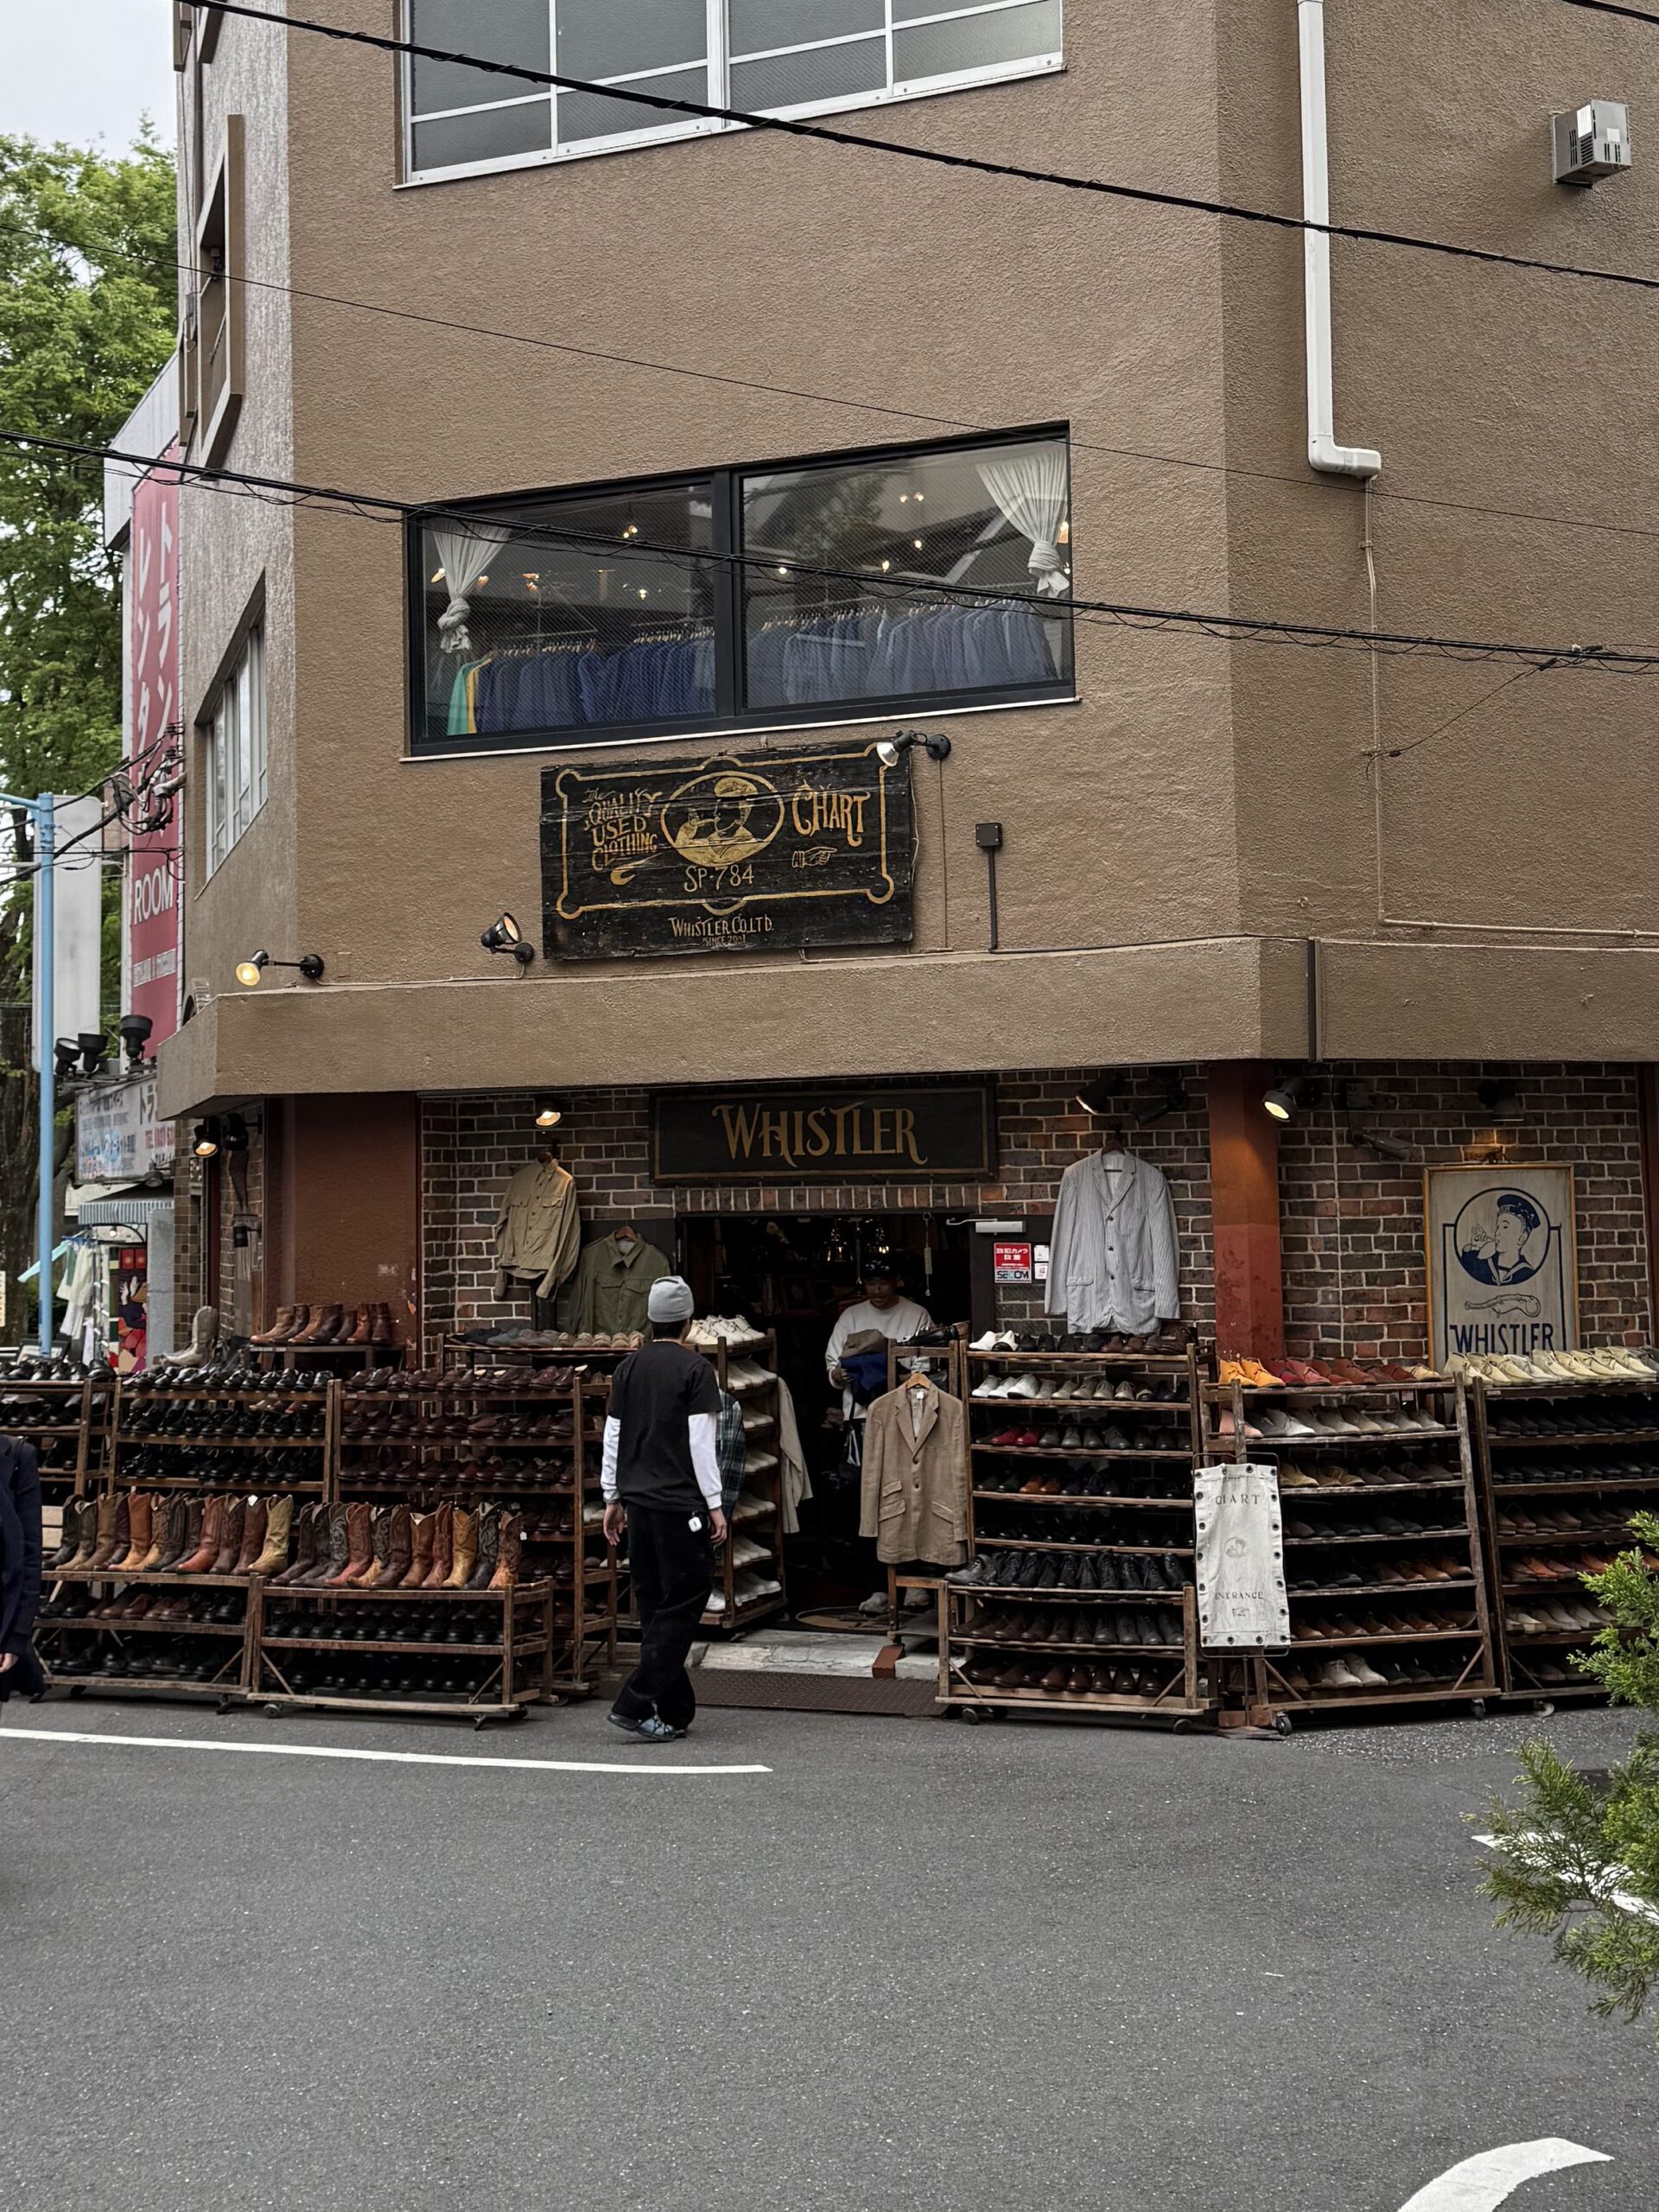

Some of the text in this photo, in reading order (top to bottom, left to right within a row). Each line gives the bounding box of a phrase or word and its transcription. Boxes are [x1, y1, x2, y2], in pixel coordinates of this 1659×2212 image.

[583, 787, 664, 830] QUALITY
[792, 779, 871, 847] CHART
[591, 832, 658, 871] CLOTHING
[592, 815, 646, 847] USED
[134, 861, 174, 925] ROOM
[712, 1101, 928, 1167] WHISTLER
[1449, 1322, 1554, 1356] WHISTLER
